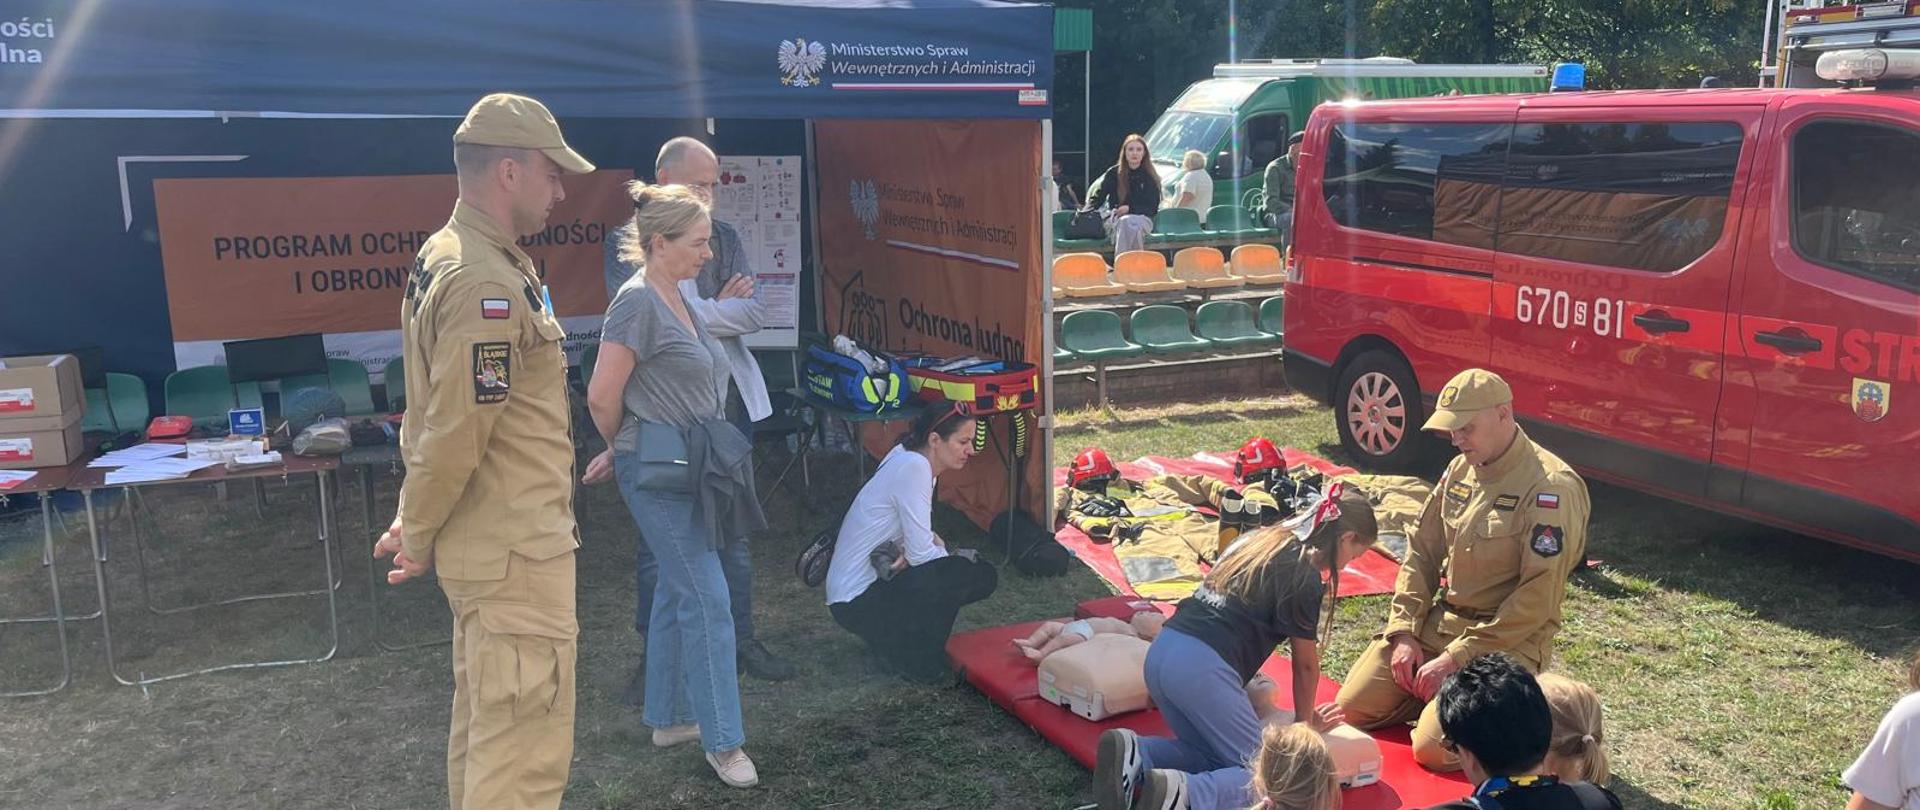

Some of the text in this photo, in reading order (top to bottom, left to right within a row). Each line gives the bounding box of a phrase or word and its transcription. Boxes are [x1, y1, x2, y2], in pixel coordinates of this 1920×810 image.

[831, 43, 969, 58] Ministerstwo Spraw
[831, 60, 1036, 77] Wewnętrznych i Administracji
[214, 233, 351, 261] PROGRAM
[294, 271, 302, 293] I
[899, 297, 1025, 363] Ochrona ludno
